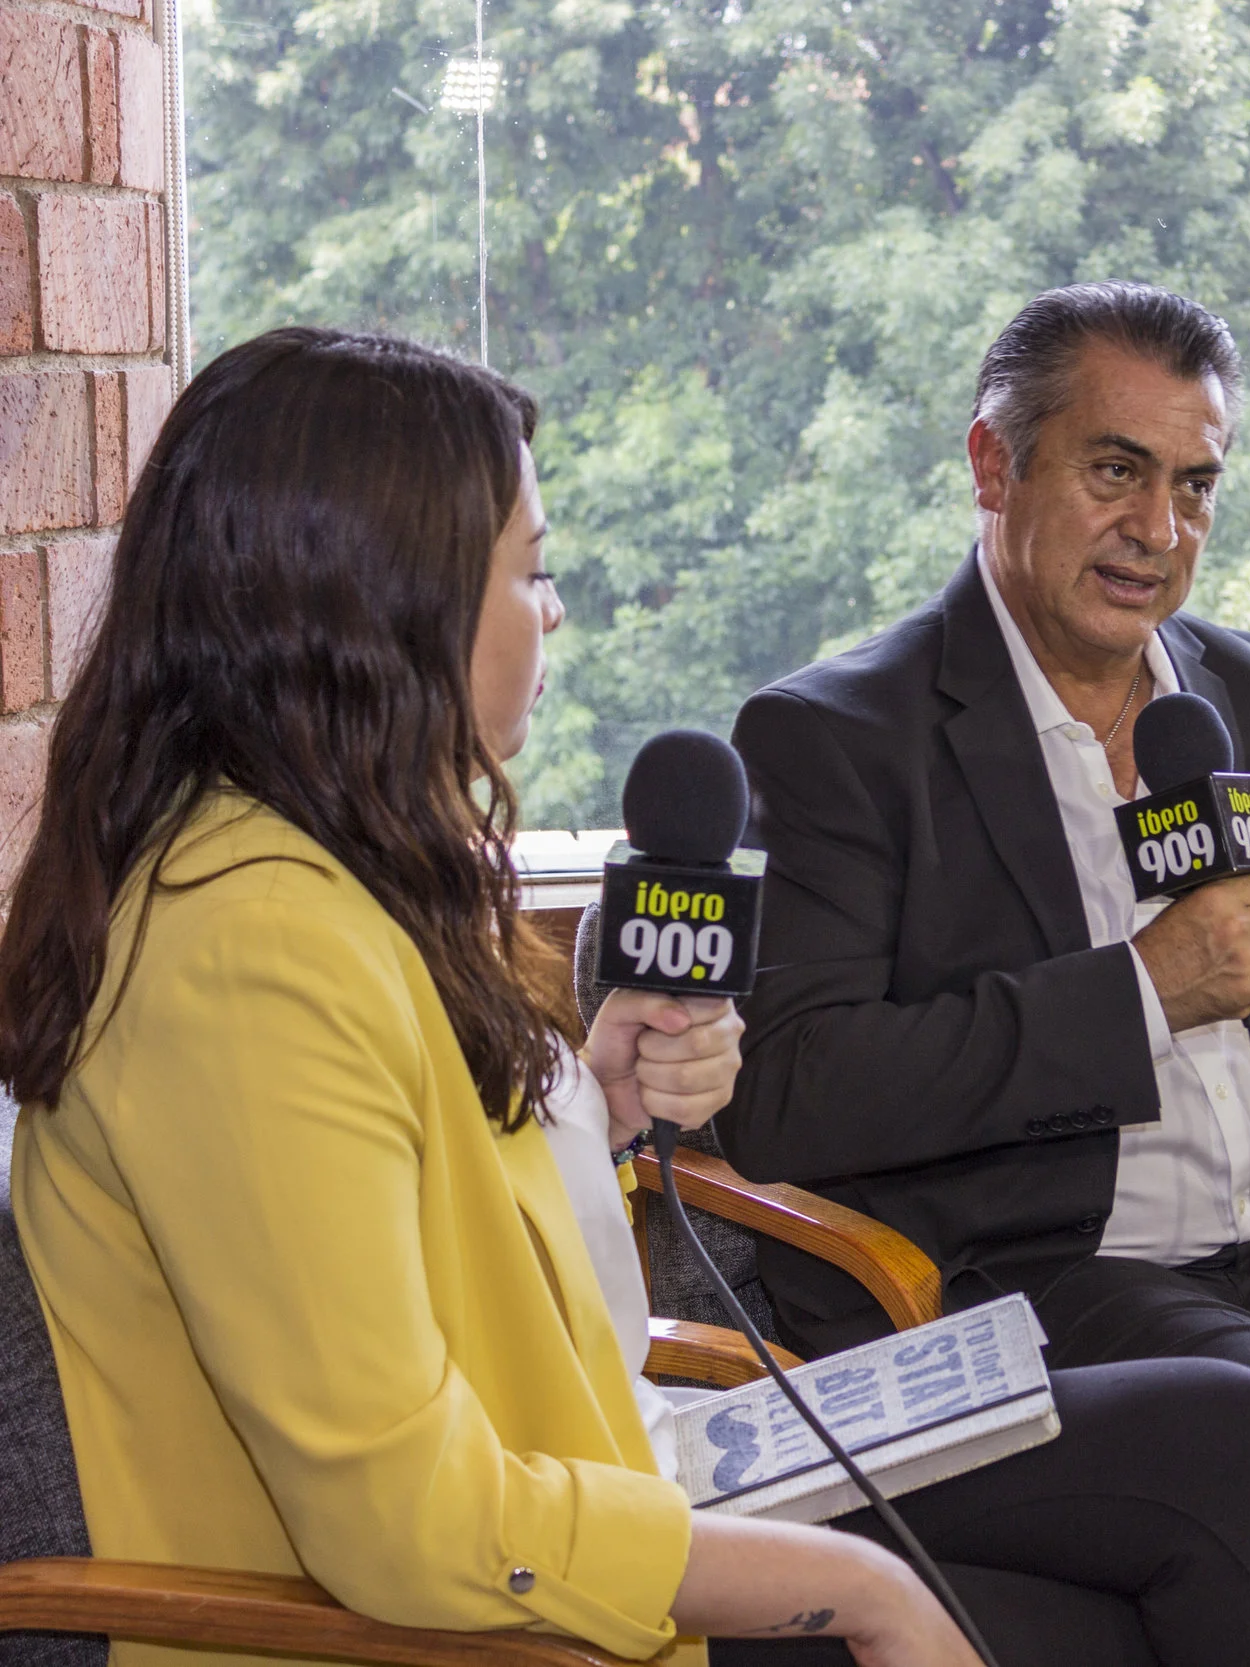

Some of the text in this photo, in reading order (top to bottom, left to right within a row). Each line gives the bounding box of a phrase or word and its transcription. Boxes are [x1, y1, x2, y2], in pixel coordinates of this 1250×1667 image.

[1136, 799, 1199, 838] ibero
[1136, 822, 1215, 884] 90.9
[635, 880, 725, 922] ibero
[619, 918, 734, 982] 90.9
[963, 1318, 996, 1347] I'D
[892, 1333, 975, 1426] STAY
[970, 1344, 1006, 1386] LOVE
[814, 1366, 887, 1433] BUT
